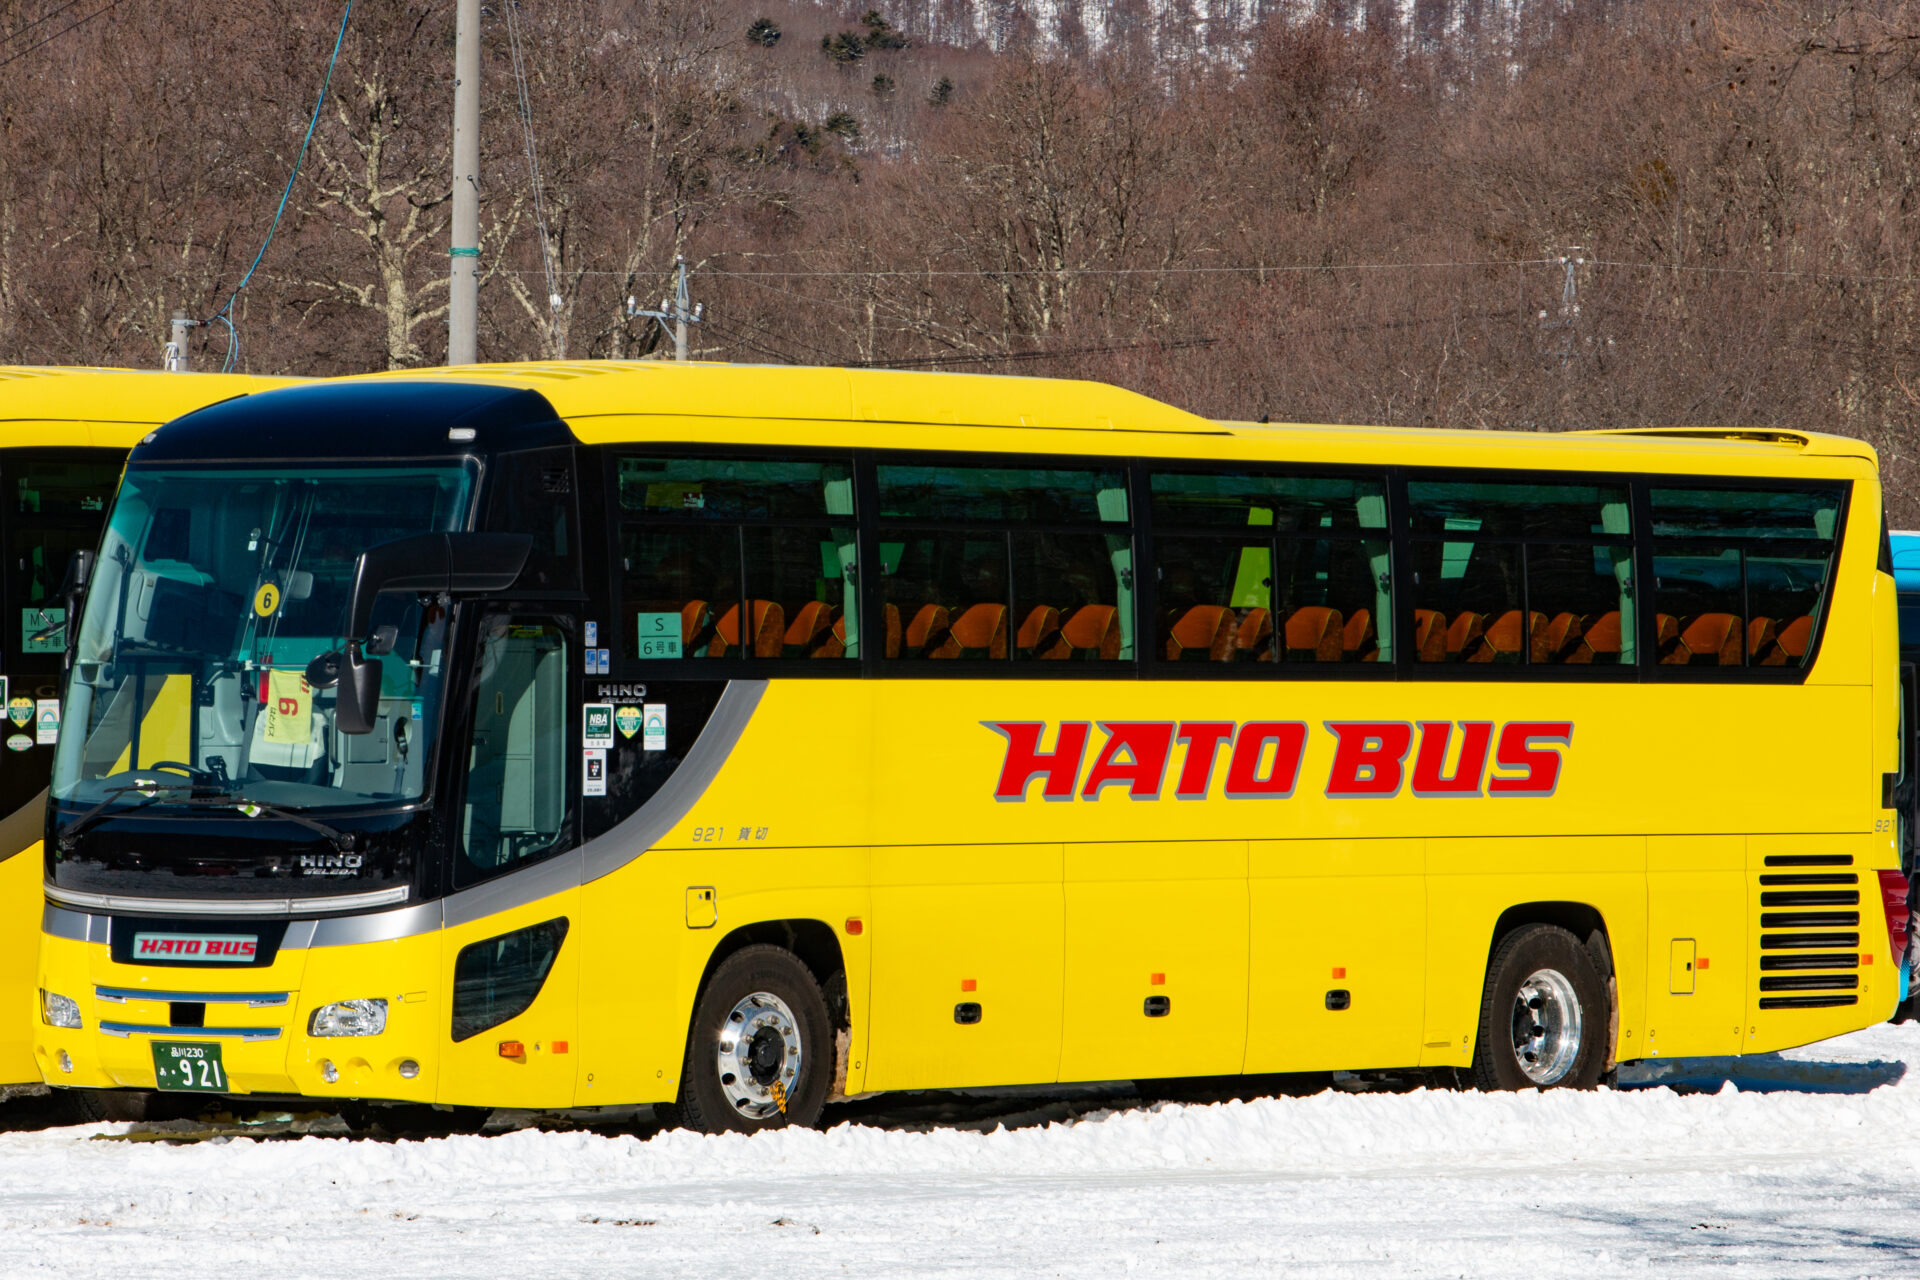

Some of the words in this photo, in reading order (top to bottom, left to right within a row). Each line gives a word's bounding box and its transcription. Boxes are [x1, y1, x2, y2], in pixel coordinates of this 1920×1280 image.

[263, 592, 272, 609] 6
[655, 617, 664, 632] S
[643, 641, 677, 655] 6号車
[598, 684, 647, 697] HINO
[589, 713, 608, 725] NBA
[979, 720, 1308, 802] HATO
[1323, 720, 1575, 799] BUS
[1875, 819, 1895, 832] 921
[692, 827, 724, 842] 921
[300, 855, 362, 868] HINO
[139, 939, 202, 954] HATO
[205, 940, 257, 955] BUS
